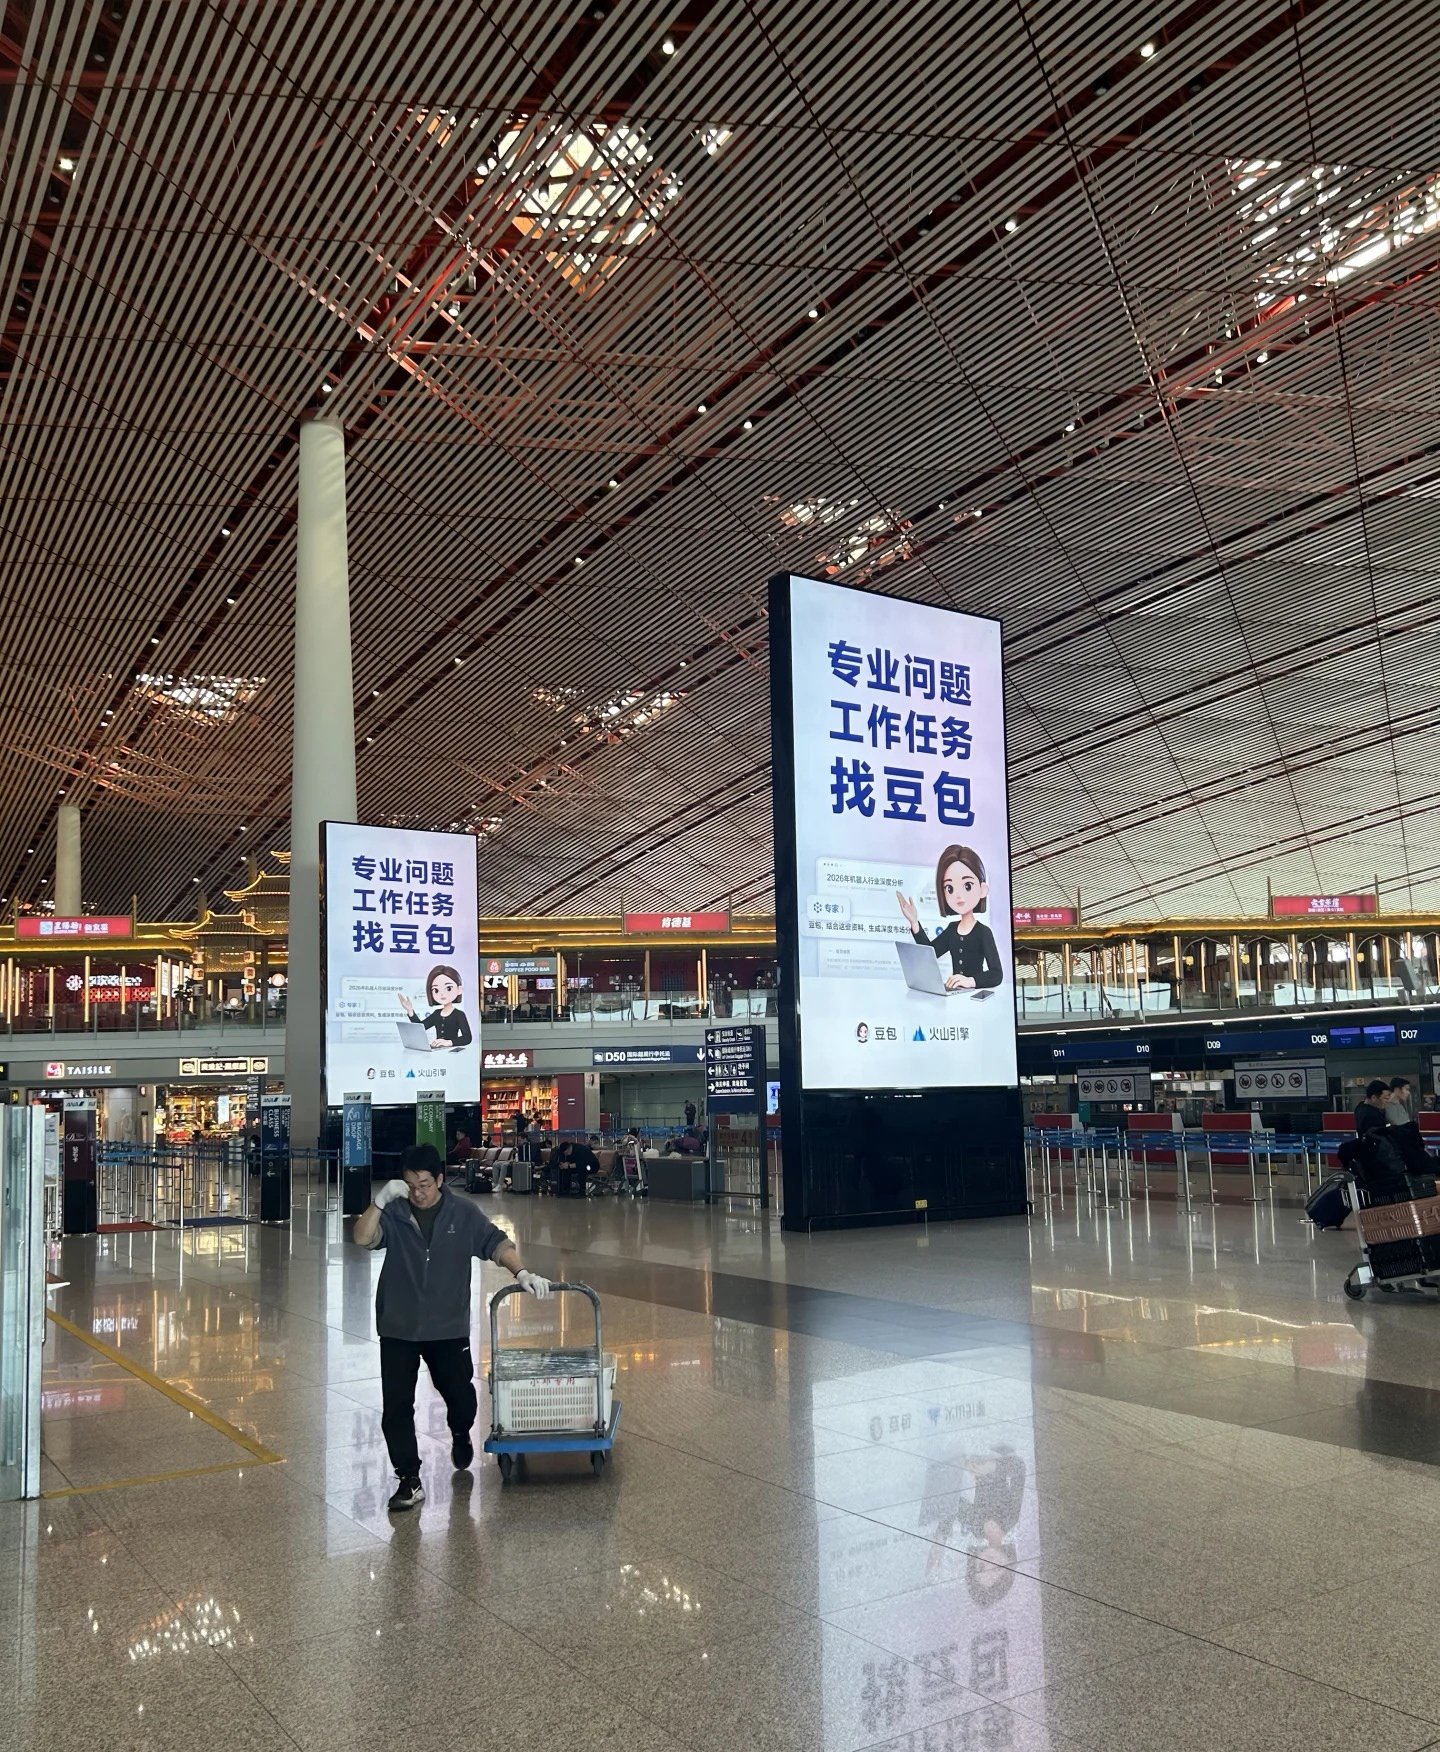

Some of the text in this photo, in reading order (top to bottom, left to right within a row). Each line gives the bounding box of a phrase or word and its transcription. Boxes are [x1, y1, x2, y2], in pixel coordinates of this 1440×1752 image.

[827, 639, 972, 707] 专业问题
[829, 699, 973, 760] 工作任务
[830, 756, 976, 827] 找豆包
[352, 855, 454, 887] 专业问题
[826, 873, 904, 887] 2026年机器人行业深度分析
[352, 889, 454, 917] 工作任务
[824, 903, 840, 913] 专家
[661, 916, 692, 928] 肯德基
[353, 920, 455, 955] 找豆包
[874, 1026, 897, 1041] 豆包
[929, 1027, 970, 1041] 火山引擎
[1311, 1034, 1328, 1044] D08
[1400, 1029, 1418, 1039] D07
[1136, 1045, 1150, 1053] D10
[1206, 1040, 1221, 1050] D09
[605, 1051, 626, 1062] D50
[1053, 1048, 1065, 1057] D11
[66, 1065, 112, 1075] TAISILK
[379, 1068, 395, 1078] 豆包
